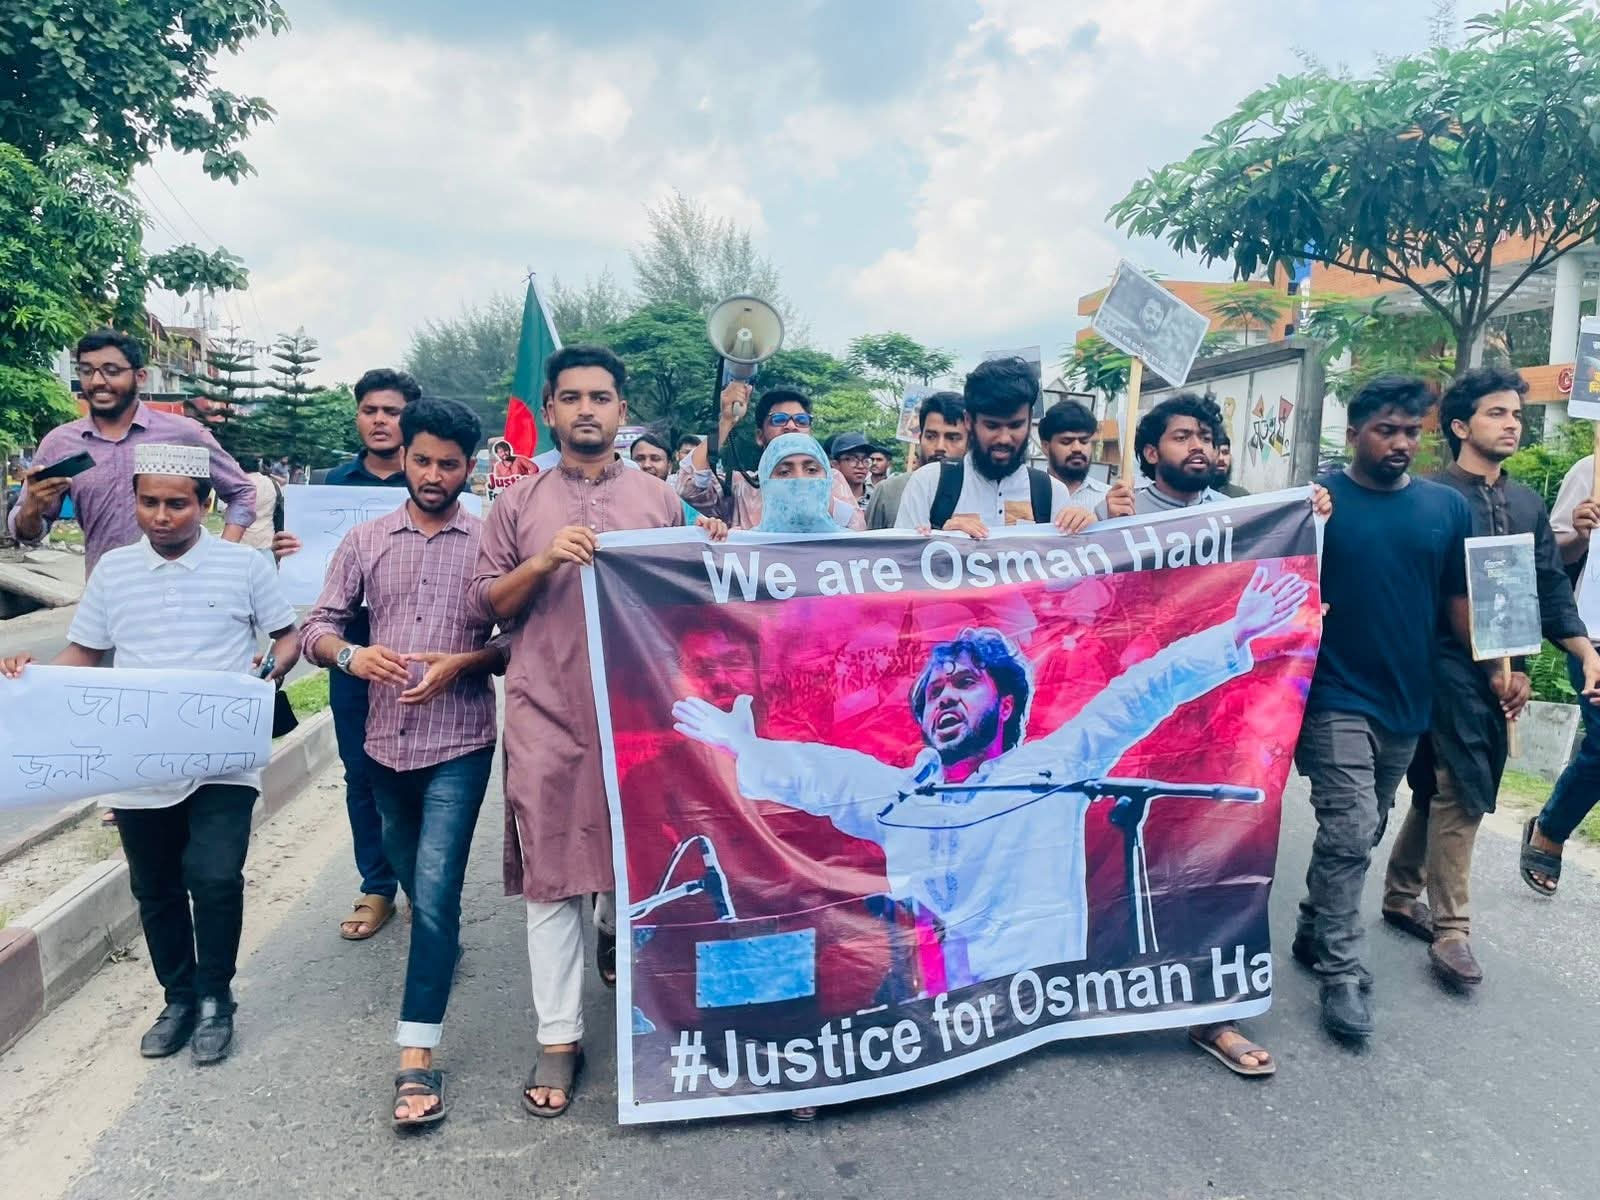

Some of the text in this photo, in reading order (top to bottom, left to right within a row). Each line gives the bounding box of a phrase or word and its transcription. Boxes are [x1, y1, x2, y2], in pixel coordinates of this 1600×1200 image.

[702, 514, 1234, 603] We are Osman Hadi
[64, 685, 168, 729] জান
[670, 945, 1272, 1093] #Justice for Osman Ha
